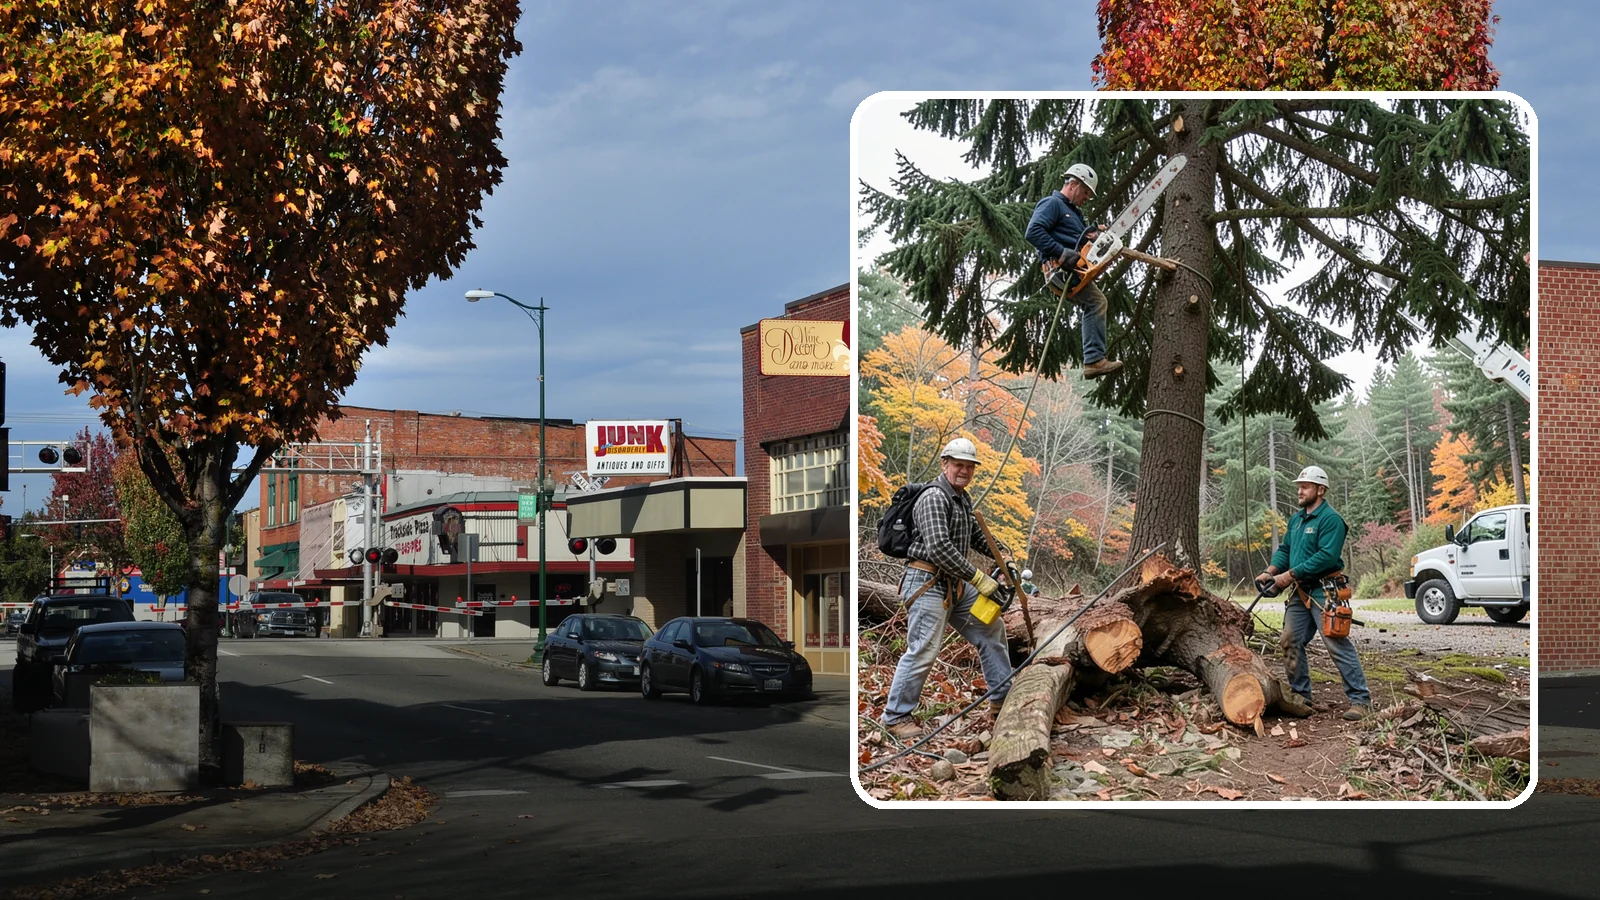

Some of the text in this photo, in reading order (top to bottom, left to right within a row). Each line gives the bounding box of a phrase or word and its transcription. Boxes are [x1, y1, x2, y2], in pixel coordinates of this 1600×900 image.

[595, 425, 666, 457] JUNK
[607, 446, 646, 454] DISORDERLY
[597, 460, 665, 470] ANTIQUES AND GIFTS
[414, 519, 429, 535] Pizza
